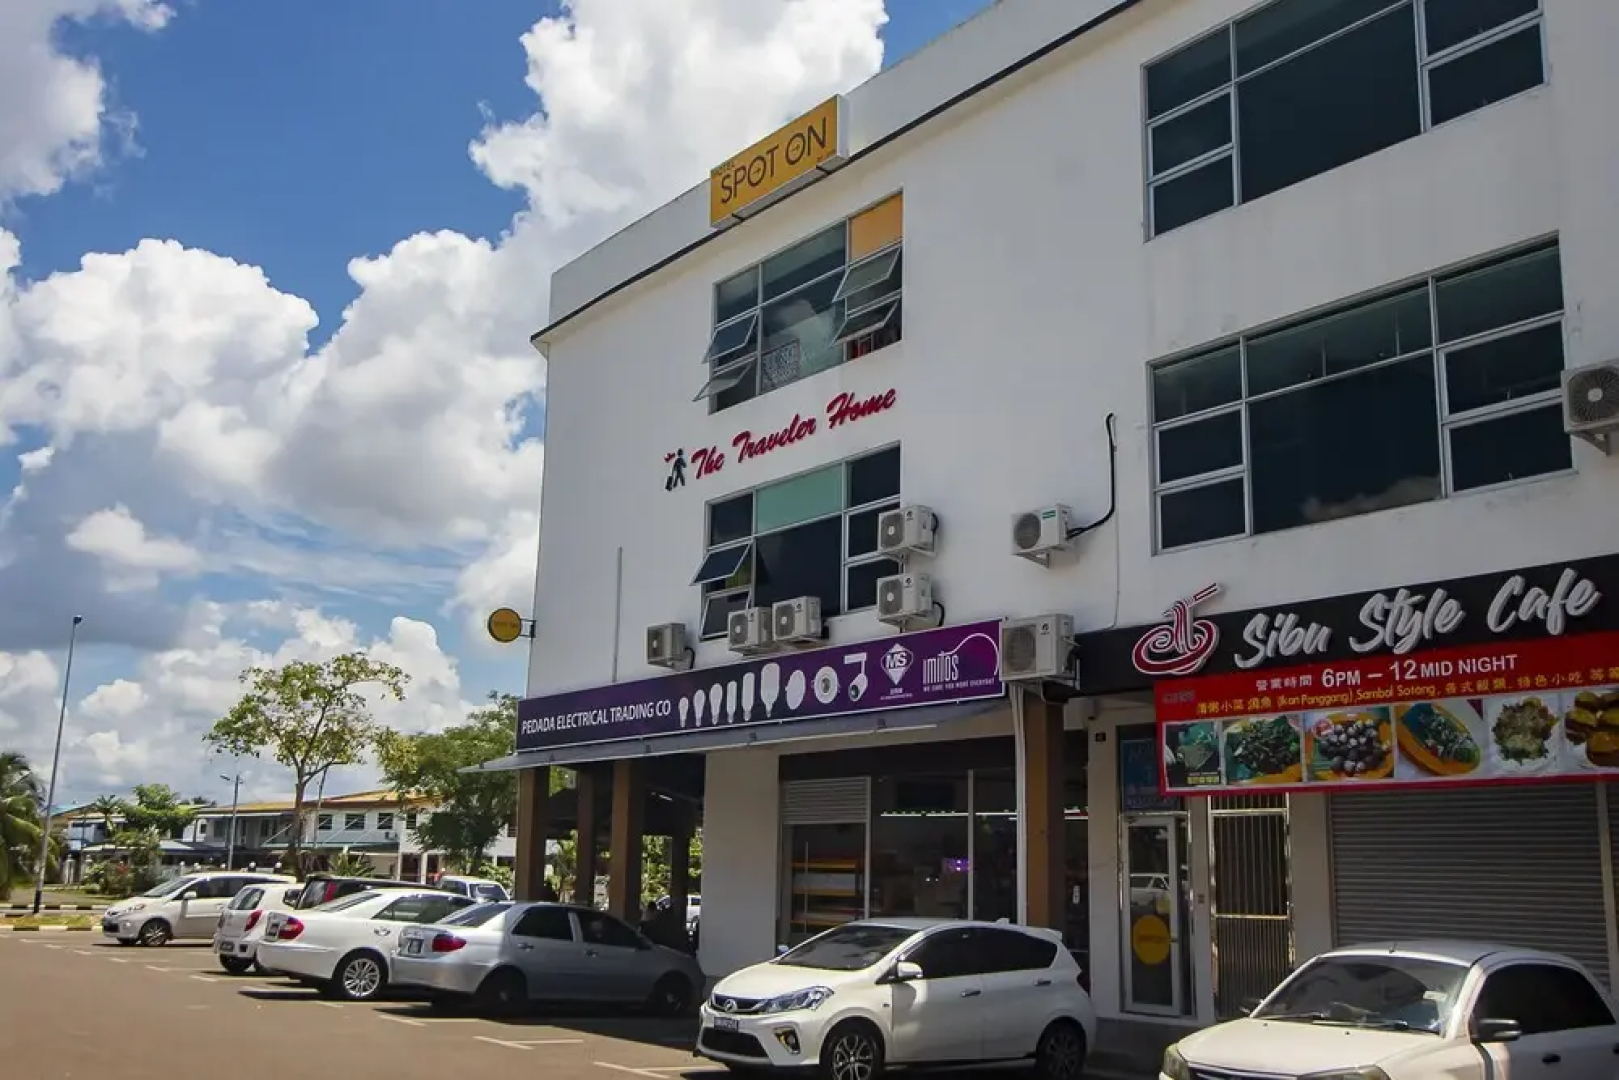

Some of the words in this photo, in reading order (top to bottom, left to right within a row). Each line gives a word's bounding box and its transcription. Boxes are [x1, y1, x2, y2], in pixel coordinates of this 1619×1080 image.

[721, 144, 779, 204] SPOT
[785, 116, 827, 165] ON
[691, 446, 725, 479] The
[732, 414, 816, 463] Traveler
[826, 388, 896, 429] Home
[1234, 613, 1333, 669] Sibu
[1349, 588, 1466, 655] Style
[1487, 568, 1601, 635] Cafe
[886, 652, 905, 668] MS
[1322, 668, 1361, 688] 6PM
[1458, 654, 1517, 674] NIGHT
[521, 717, 556, 735] PEDADA
[556, 709, 609, 730] ELECTRICAL
[610, 702, 654, 723] TRADING
[655, 700, 671, 716] CO
